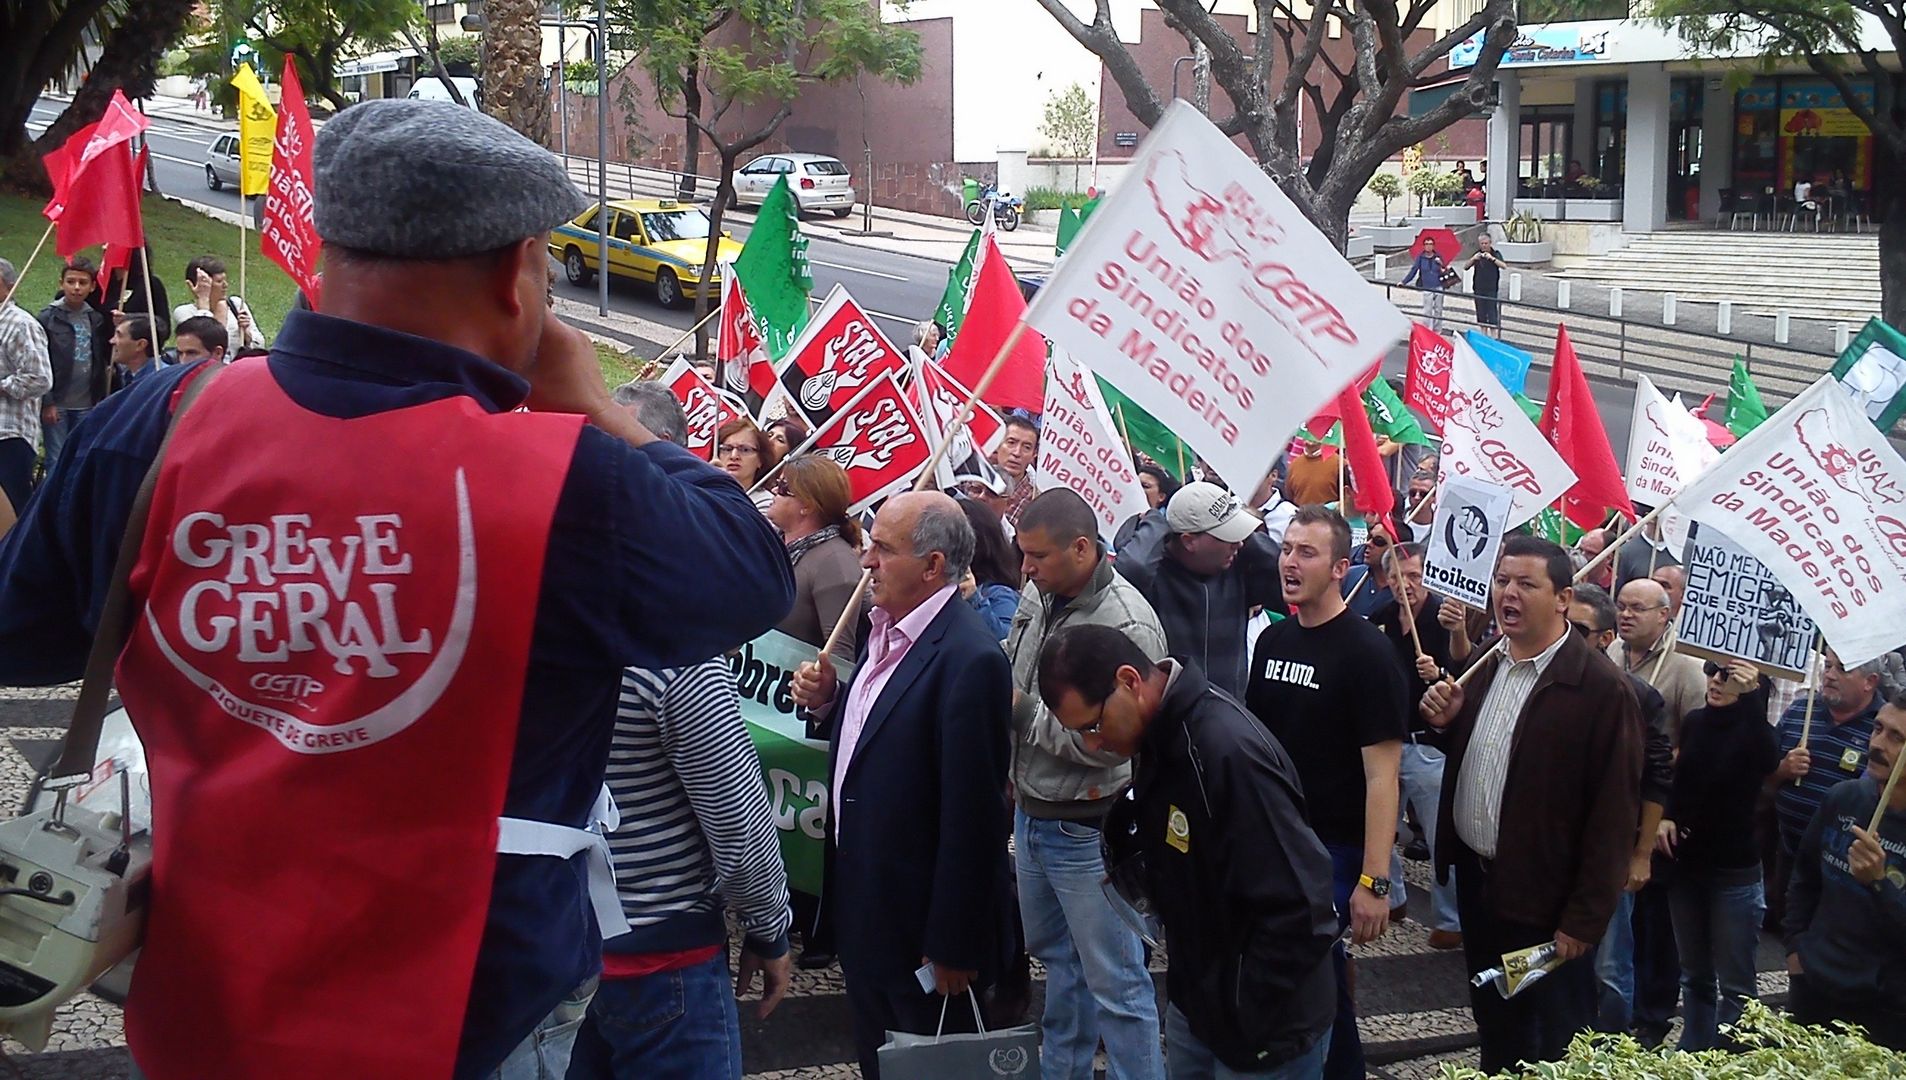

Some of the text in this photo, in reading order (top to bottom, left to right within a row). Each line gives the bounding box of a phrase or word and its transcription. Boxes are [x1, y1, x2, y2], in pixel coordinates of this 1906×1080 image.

[1122, 229, 1219, 320] União
[1220, 318, 1274, 378] dos
[1253, 261, 1360, 346] CGTP
[832, 320, 886, 377] STAL
[1095, 260, 1258, 412] Sindicatos
[1067, 296, 1240, 448] da Madeira
[856, 398, 917, 460] STAL
[1041, 452, 1116, 526] Madeira
[1042, 421, 1124, 505] indicatos
[1097, 447, 1135, 484] dos
[1480, 440, 1542, 496] CGTP
[1635, 475, 1649, 489] da
[1739, 470, 1867, 607] Sindicatos
[1766, 451, 1883, 594] União dos
[173, 511, 412, 601] GREVE
[1425, 560, 1487, 597] troikas
[1692, 544, 1727, 568] NÃO
[1729, 553, 1753, 575] ME
[1711, 491, 1849, 620] da Madeira
[178, 580, 432, 678] GERAL
[1679, 602, 1753, 656] TAMBÉM
[1686, 590, 1719, 608] QUE
[1725, 601, 1769, 621] ESTE
[250, 671, 326, 698] CGTP
[1265, 659, 1320, 690] DE LUTO...
[209, 682, 285, 733] PIQUETE
[286, 723, 300, 744] DE
[305, 727, 371, 749] GREVE
[997, 1048, 1021, 1063] 50
